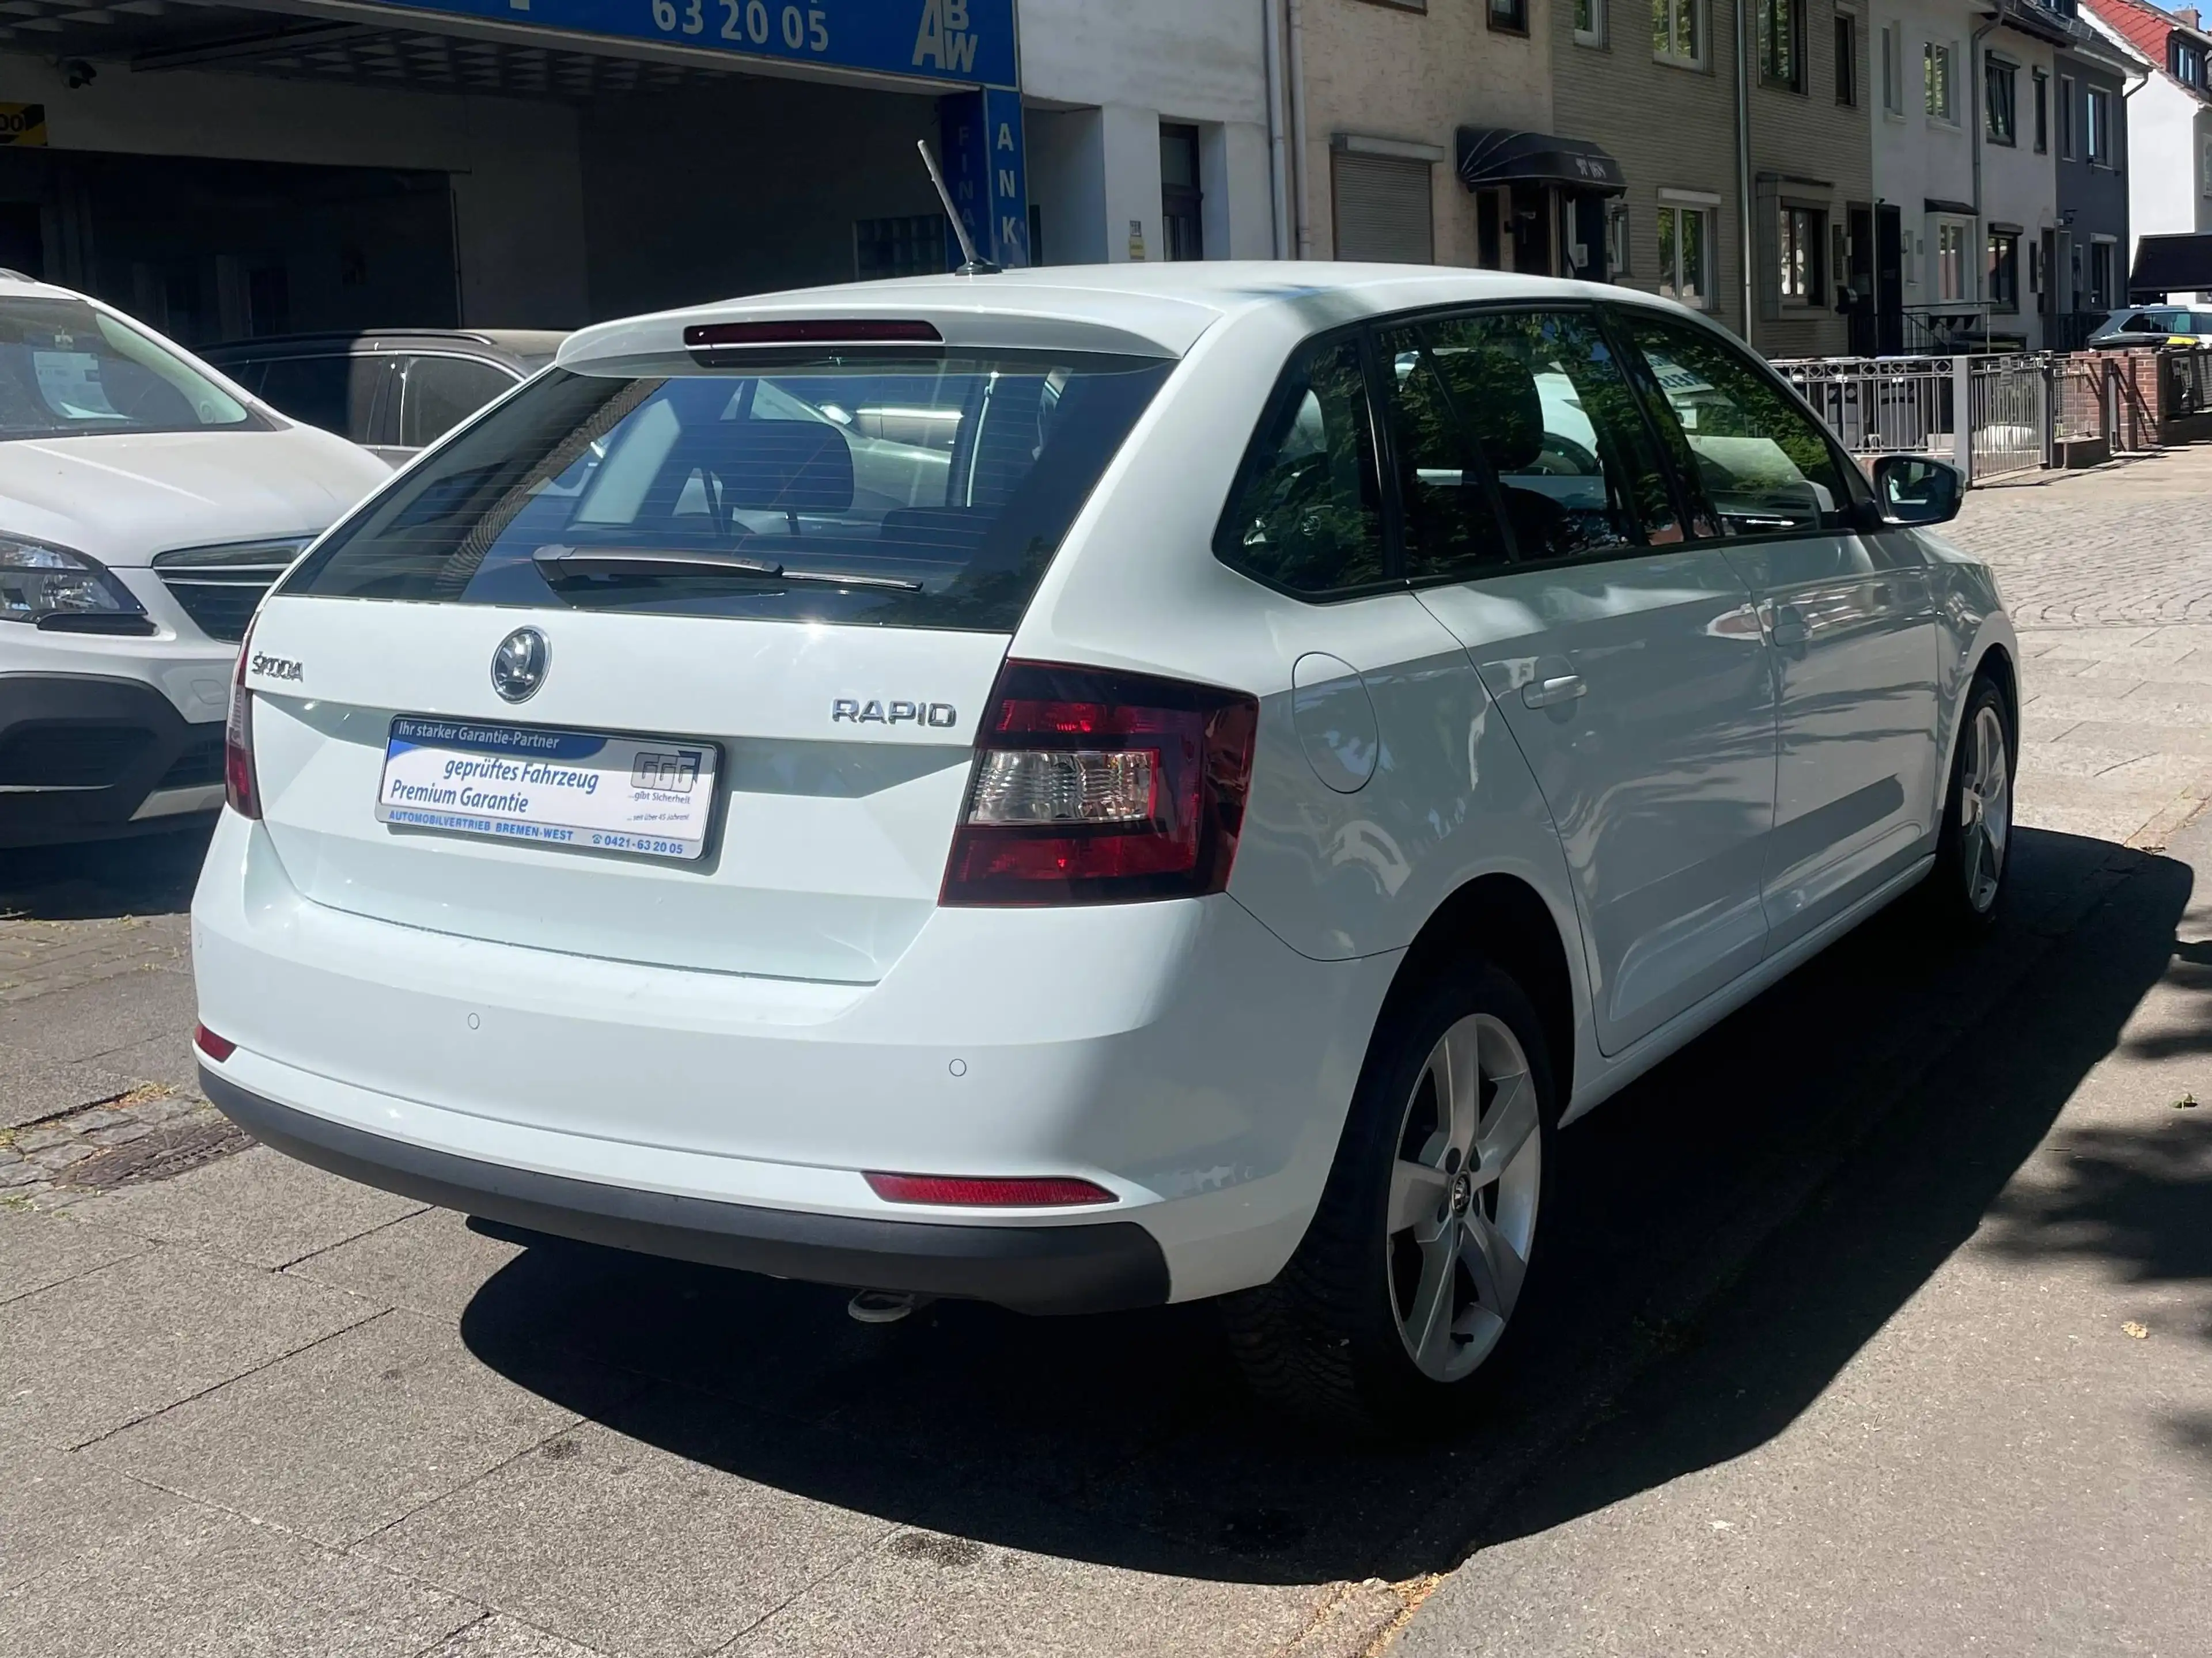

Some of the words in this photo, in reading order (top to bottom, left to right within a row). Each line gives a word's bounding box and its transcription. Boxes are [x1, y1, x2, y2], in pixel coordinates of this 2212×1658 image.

[652, 0, 704, 35] 63
[719, 0, 768, 44] 20
[782, 6, 828, 52] 05
[958, 126, 977, 249] FINA
[997, 123, 1018, 267] ANK
[832, 698, 957, 728] RAPID
[398, 722, 414, 735] Ihr
[416, 724, 457, 740] starker
[459, 726, 559, 749] Garantie-Partner
[443, 757, 519, 781] geprüftes
[520, 762, 599, 795] Fahrzeug
[390, 779, 457, 805] Premium
[460, 787, 529, 813] Garantie
[652, 792, 690, 805] Sicherheit
[389, 810, 490, 831] AUTOMOBILVERTRIEB
[653, 841, 666, 852] 20
[669, 841, 683, 854] 05
